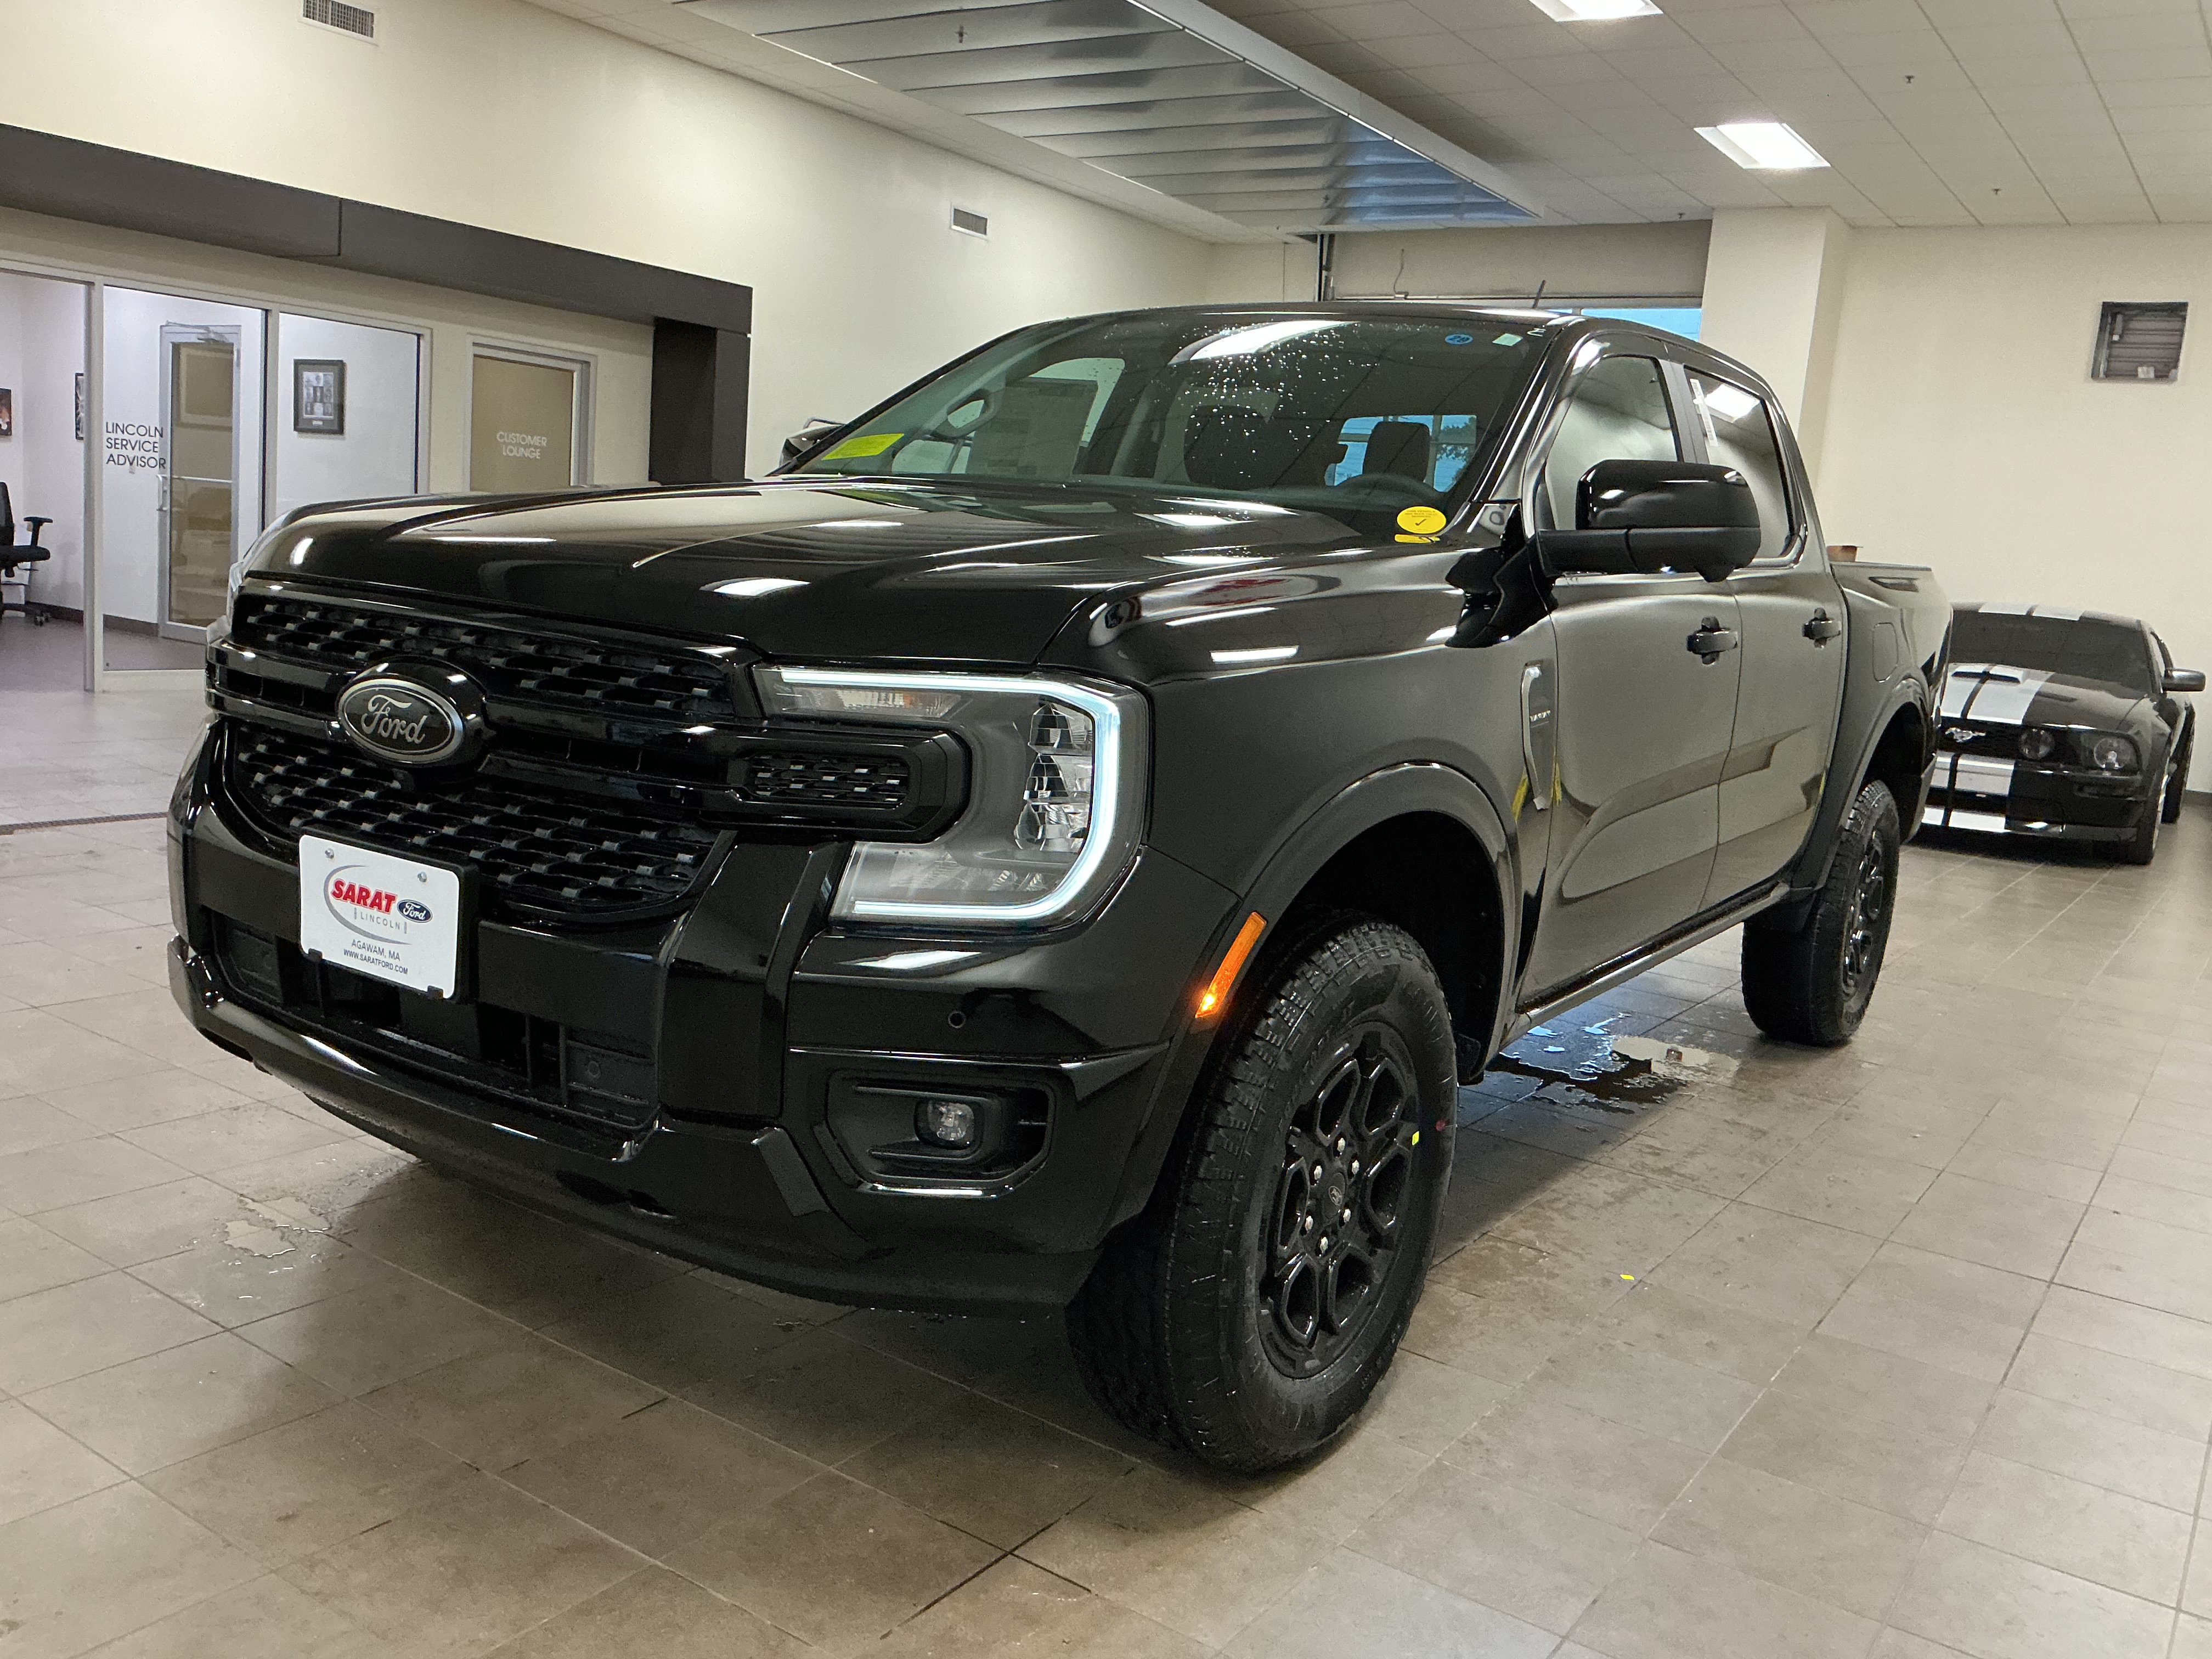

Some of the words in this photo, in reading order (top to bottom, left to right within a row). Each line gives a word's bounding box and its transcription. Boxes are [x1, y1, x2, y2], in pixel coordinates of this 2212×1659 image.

[106, 422, 163, 438] LINCOLN
[496, 432, 548, 447] CUSTOMER
[106, 437, 159, 453] SERVICE
[503, 444, 541, 459] LOUNGE
[106, 453, 166, 469] ADVISOR
[360, 694, 428, 744] Ford
[331, 878, 397, 915] SARAT
[360, 911, 401, 930] LINCOLN
[403, 902, 426, 921] Ford
[351, 939, 387, 959] AGAWAM,
[388, 950, 401, 961] MA
[343, 949, 409, 975] WWW.SARATFORD.COM
